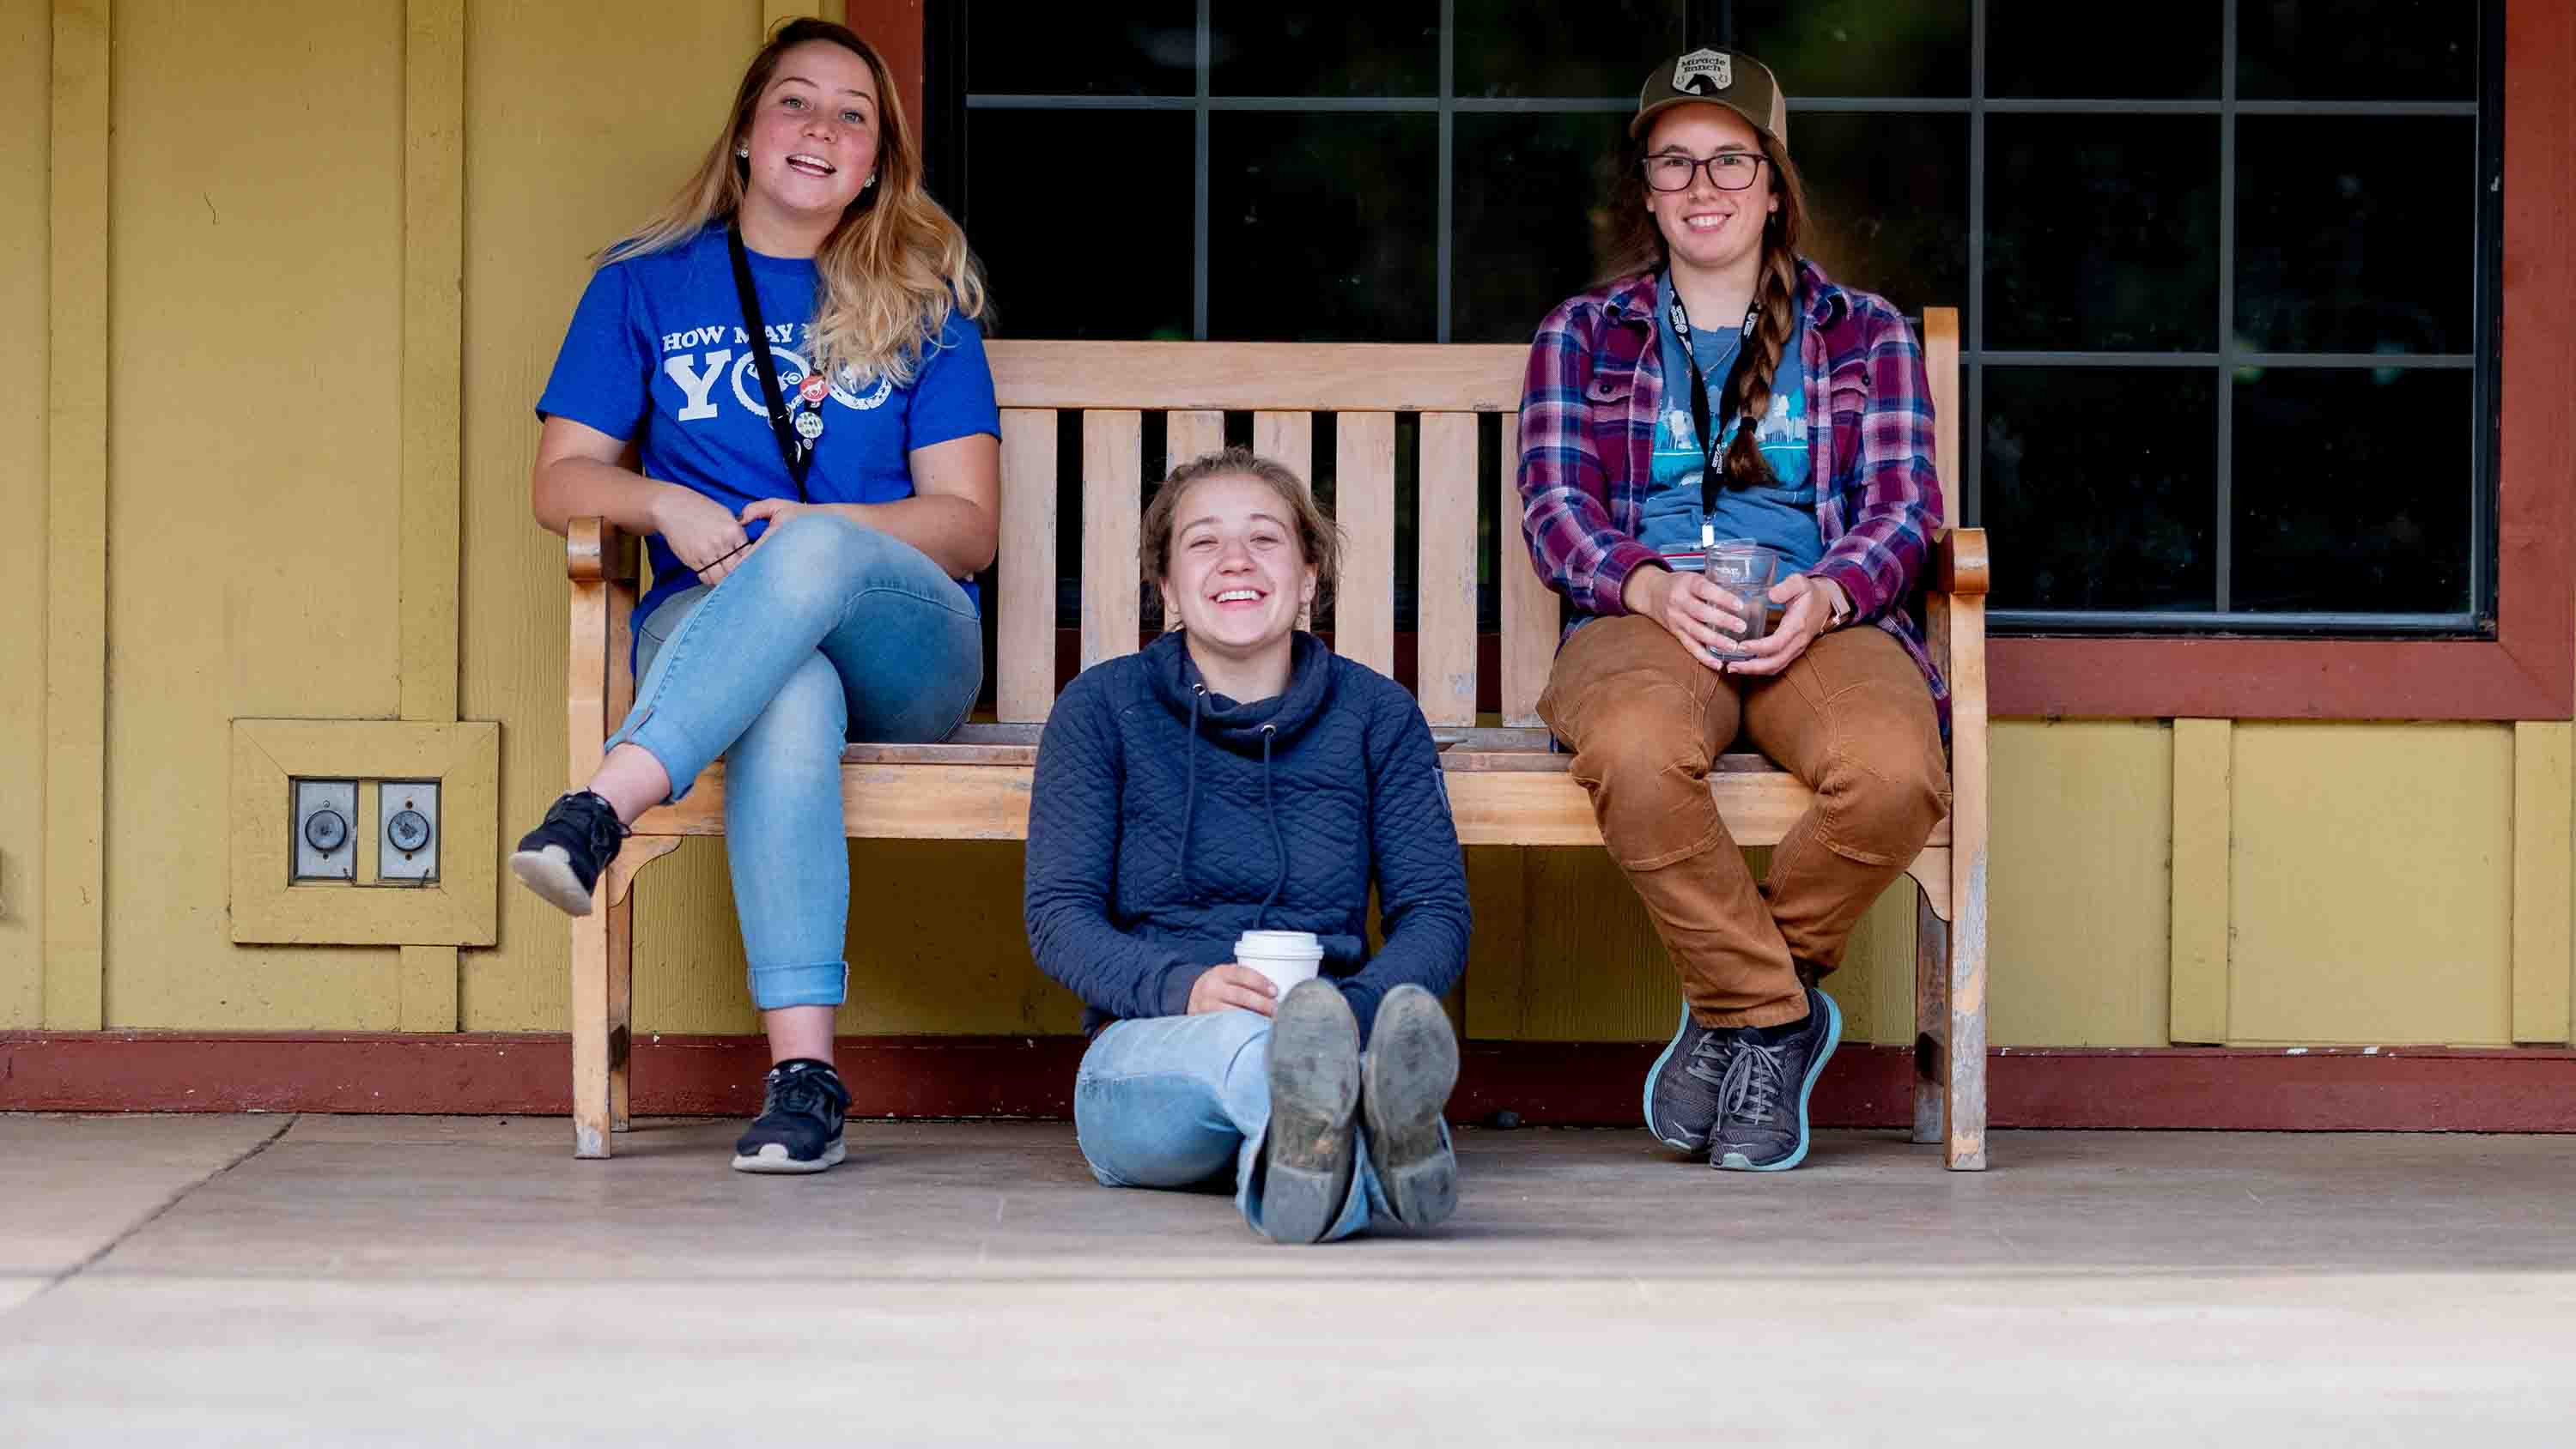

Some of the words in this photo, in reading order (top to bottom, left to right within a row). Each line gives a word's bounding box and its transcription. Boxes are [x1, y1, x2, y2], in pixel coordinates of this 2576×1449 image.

[1680, 58, 1726, 67] Miracle
[1684, 64, 1721, 73] Ranch
[662, 326, 726, 351] HOW
